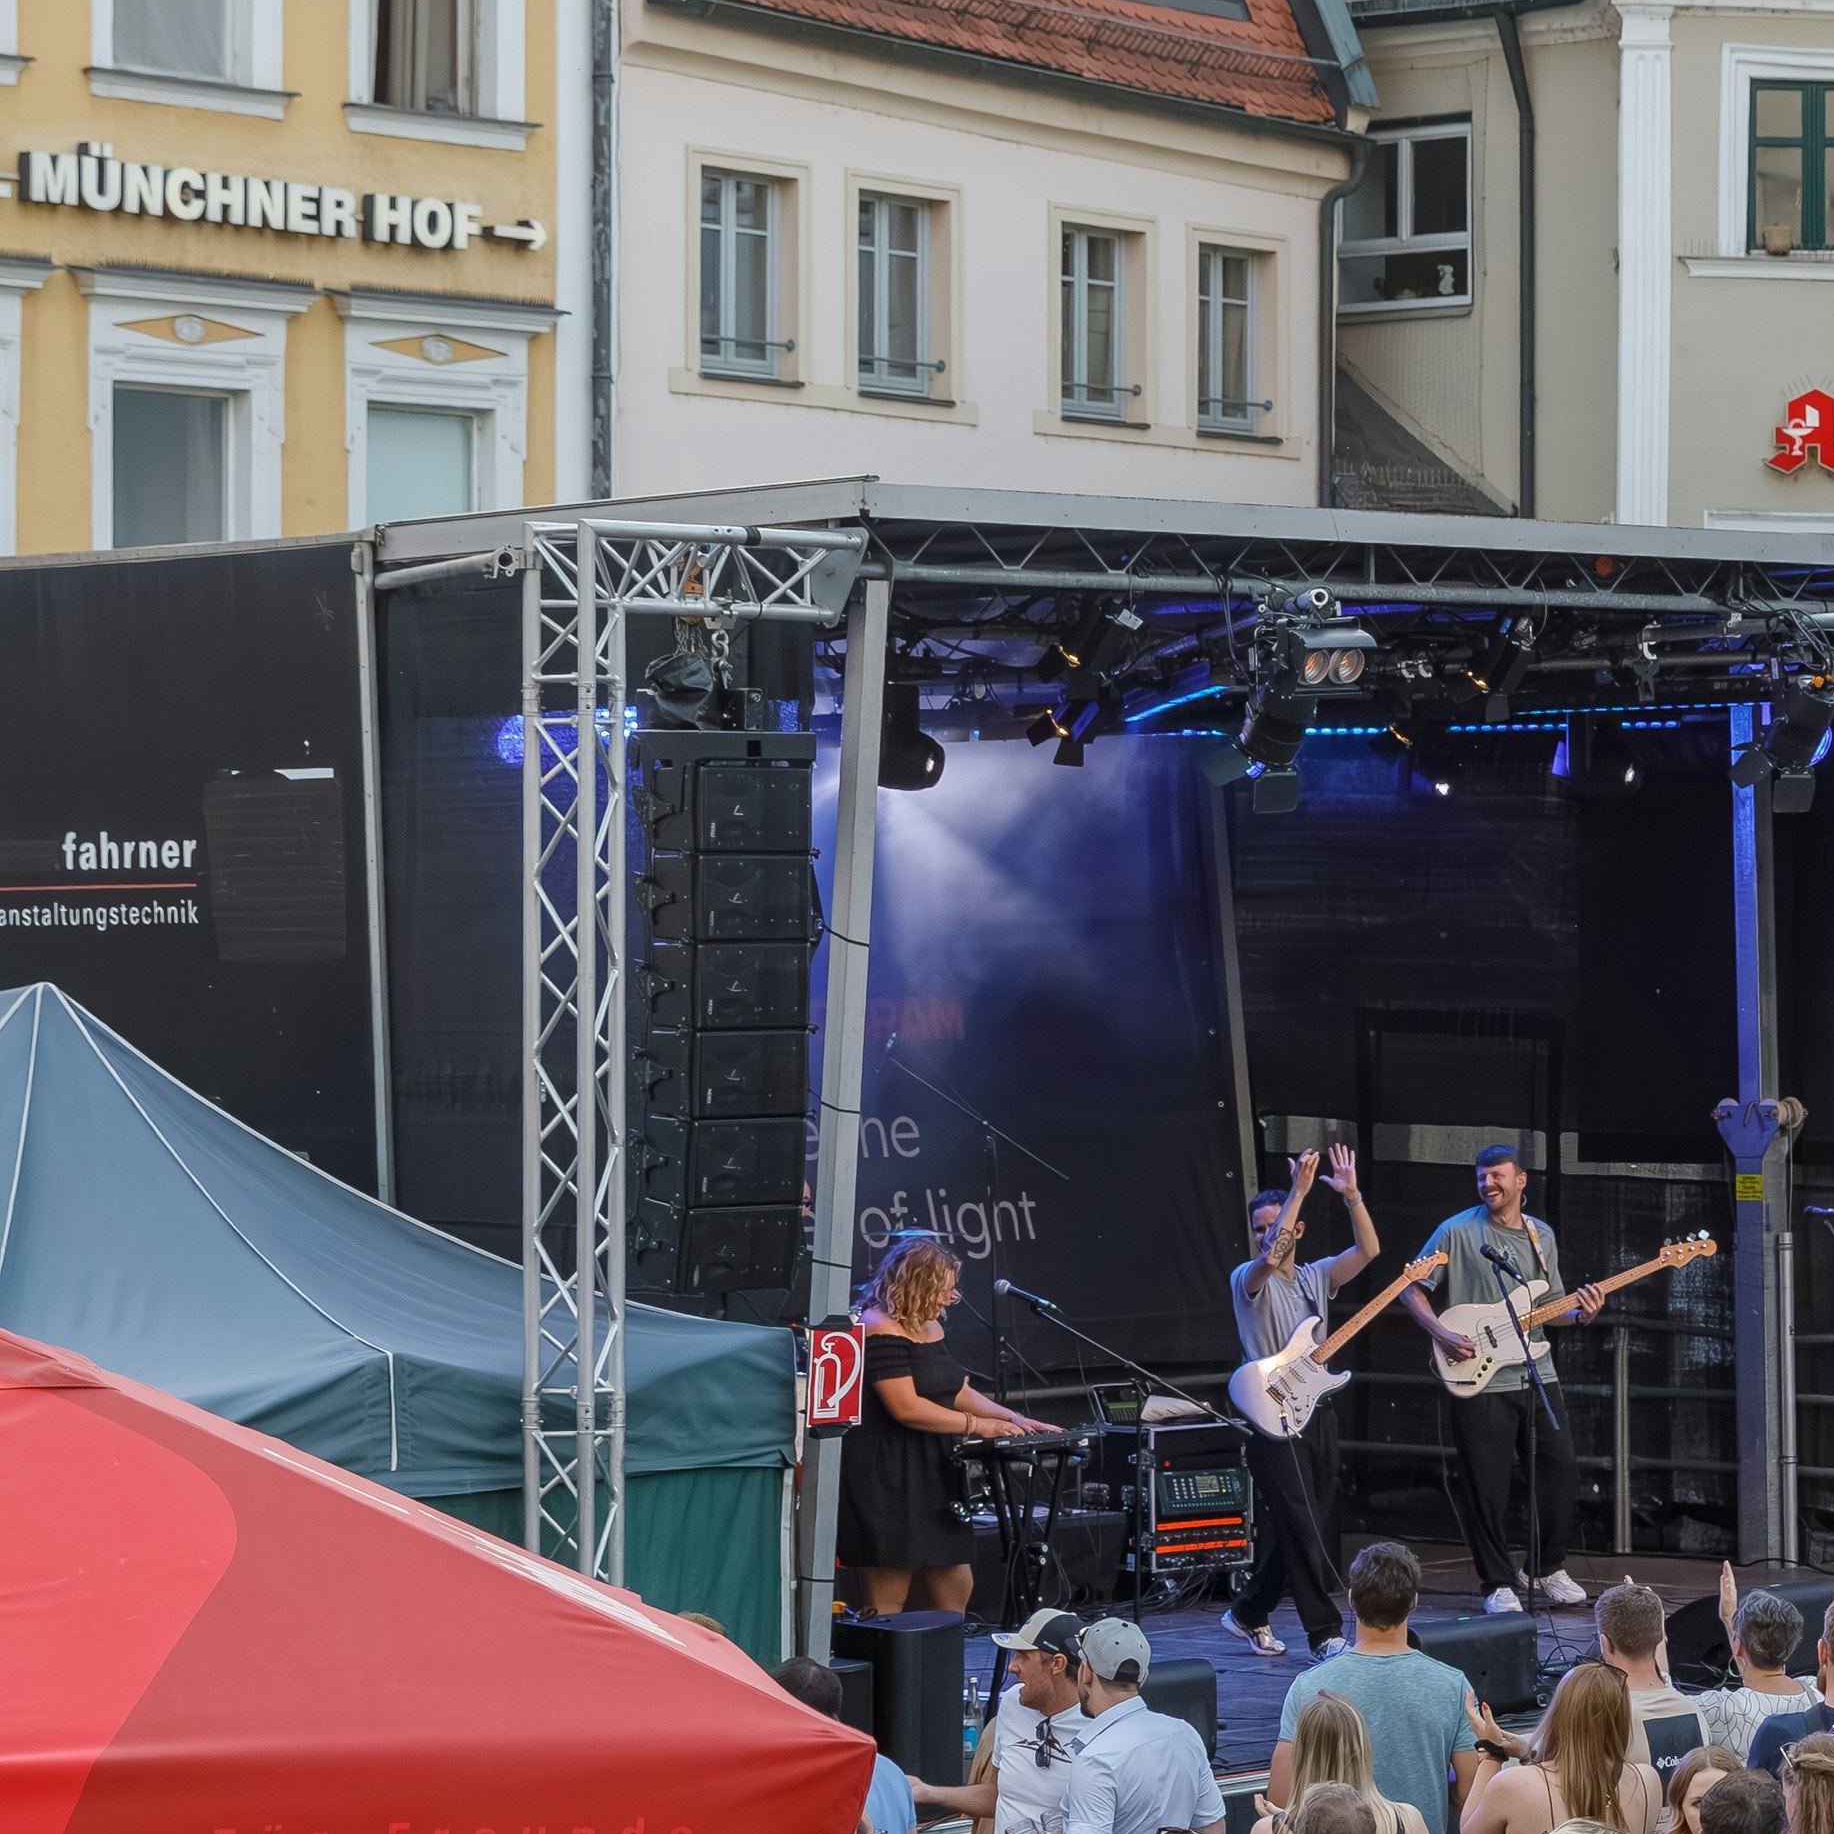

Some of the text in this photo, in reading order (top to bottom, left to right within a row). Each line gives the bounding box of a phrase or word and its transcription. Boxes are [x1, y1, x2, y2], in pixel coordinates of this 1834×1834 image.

[20, 141, 483, 250] MÜNCHNER HOF
[62, 831, 197, 871] fahrner
